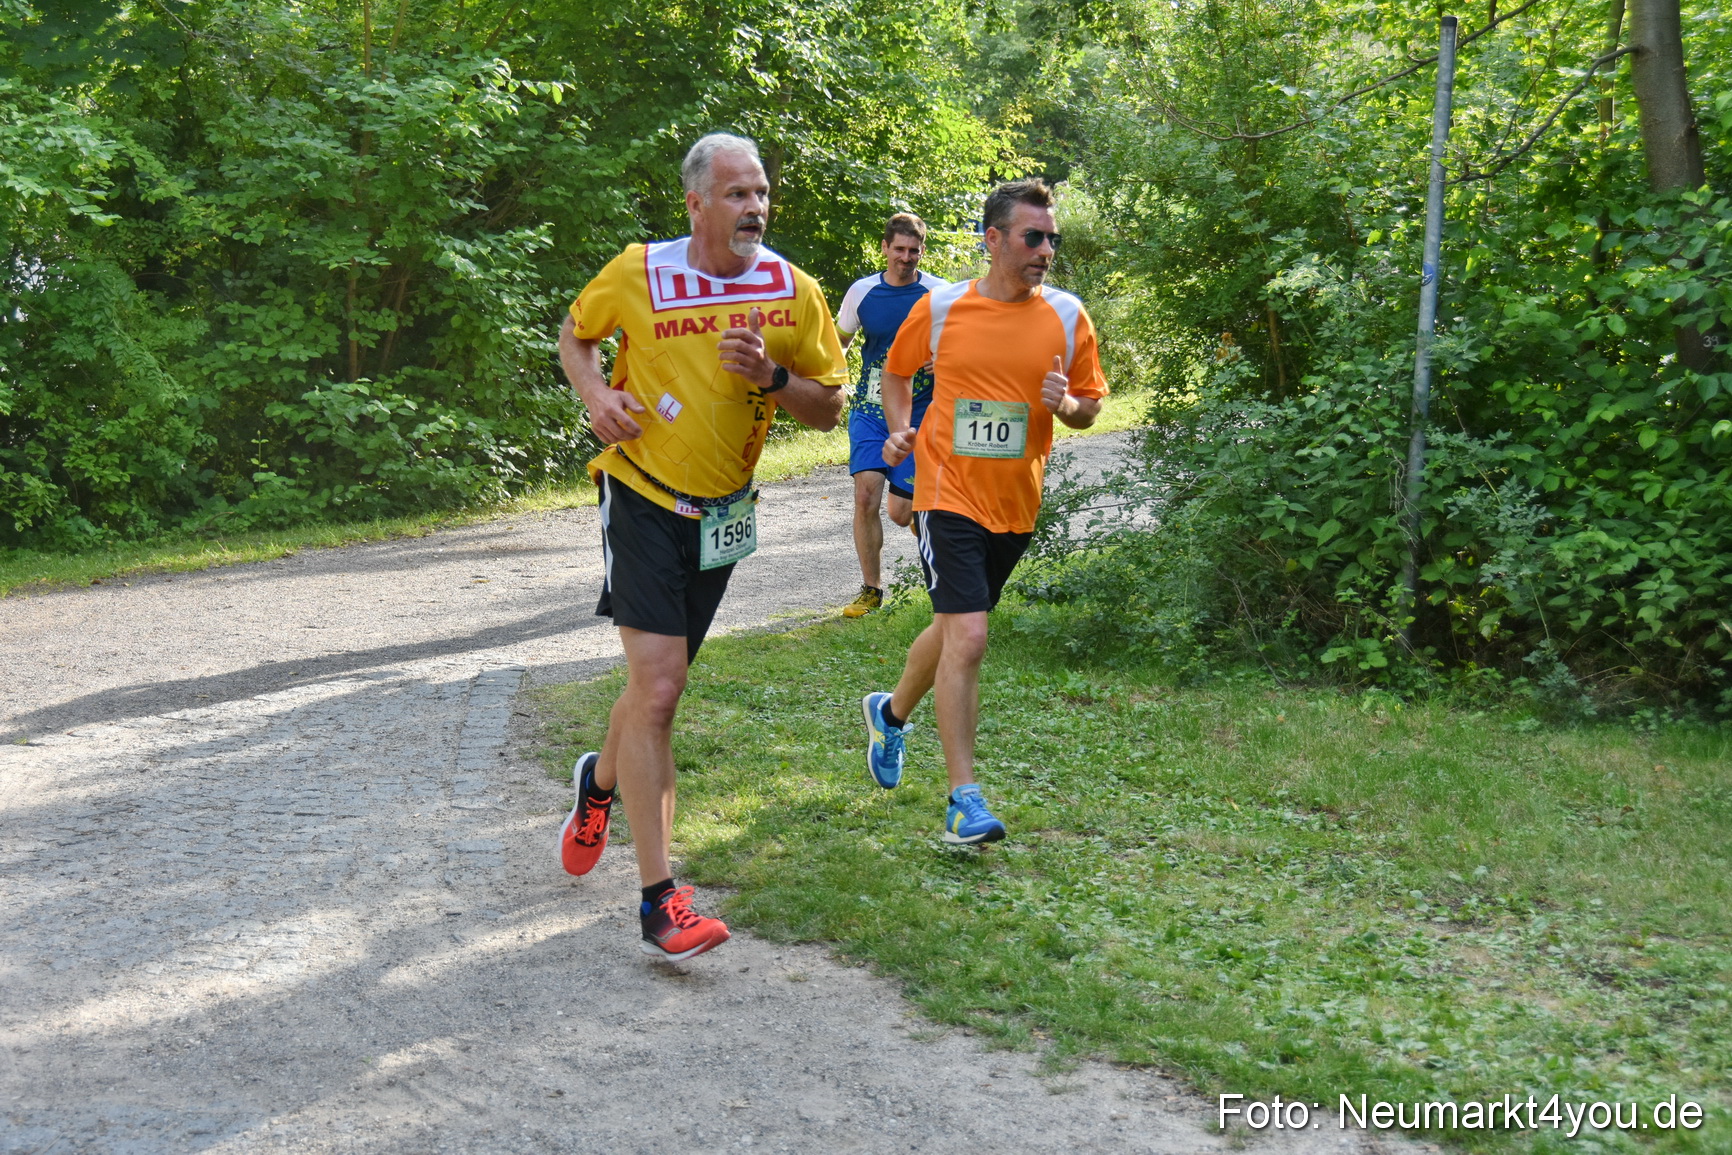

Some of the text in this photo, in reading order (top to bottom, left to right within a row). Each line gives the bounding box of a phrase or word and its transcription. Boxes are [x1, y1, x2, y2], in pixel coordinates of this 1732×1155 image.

[654, 315, 720, 340] MAX
[968, 420, 1010, 443] 110
[711, 516, 752, 550] 1596
